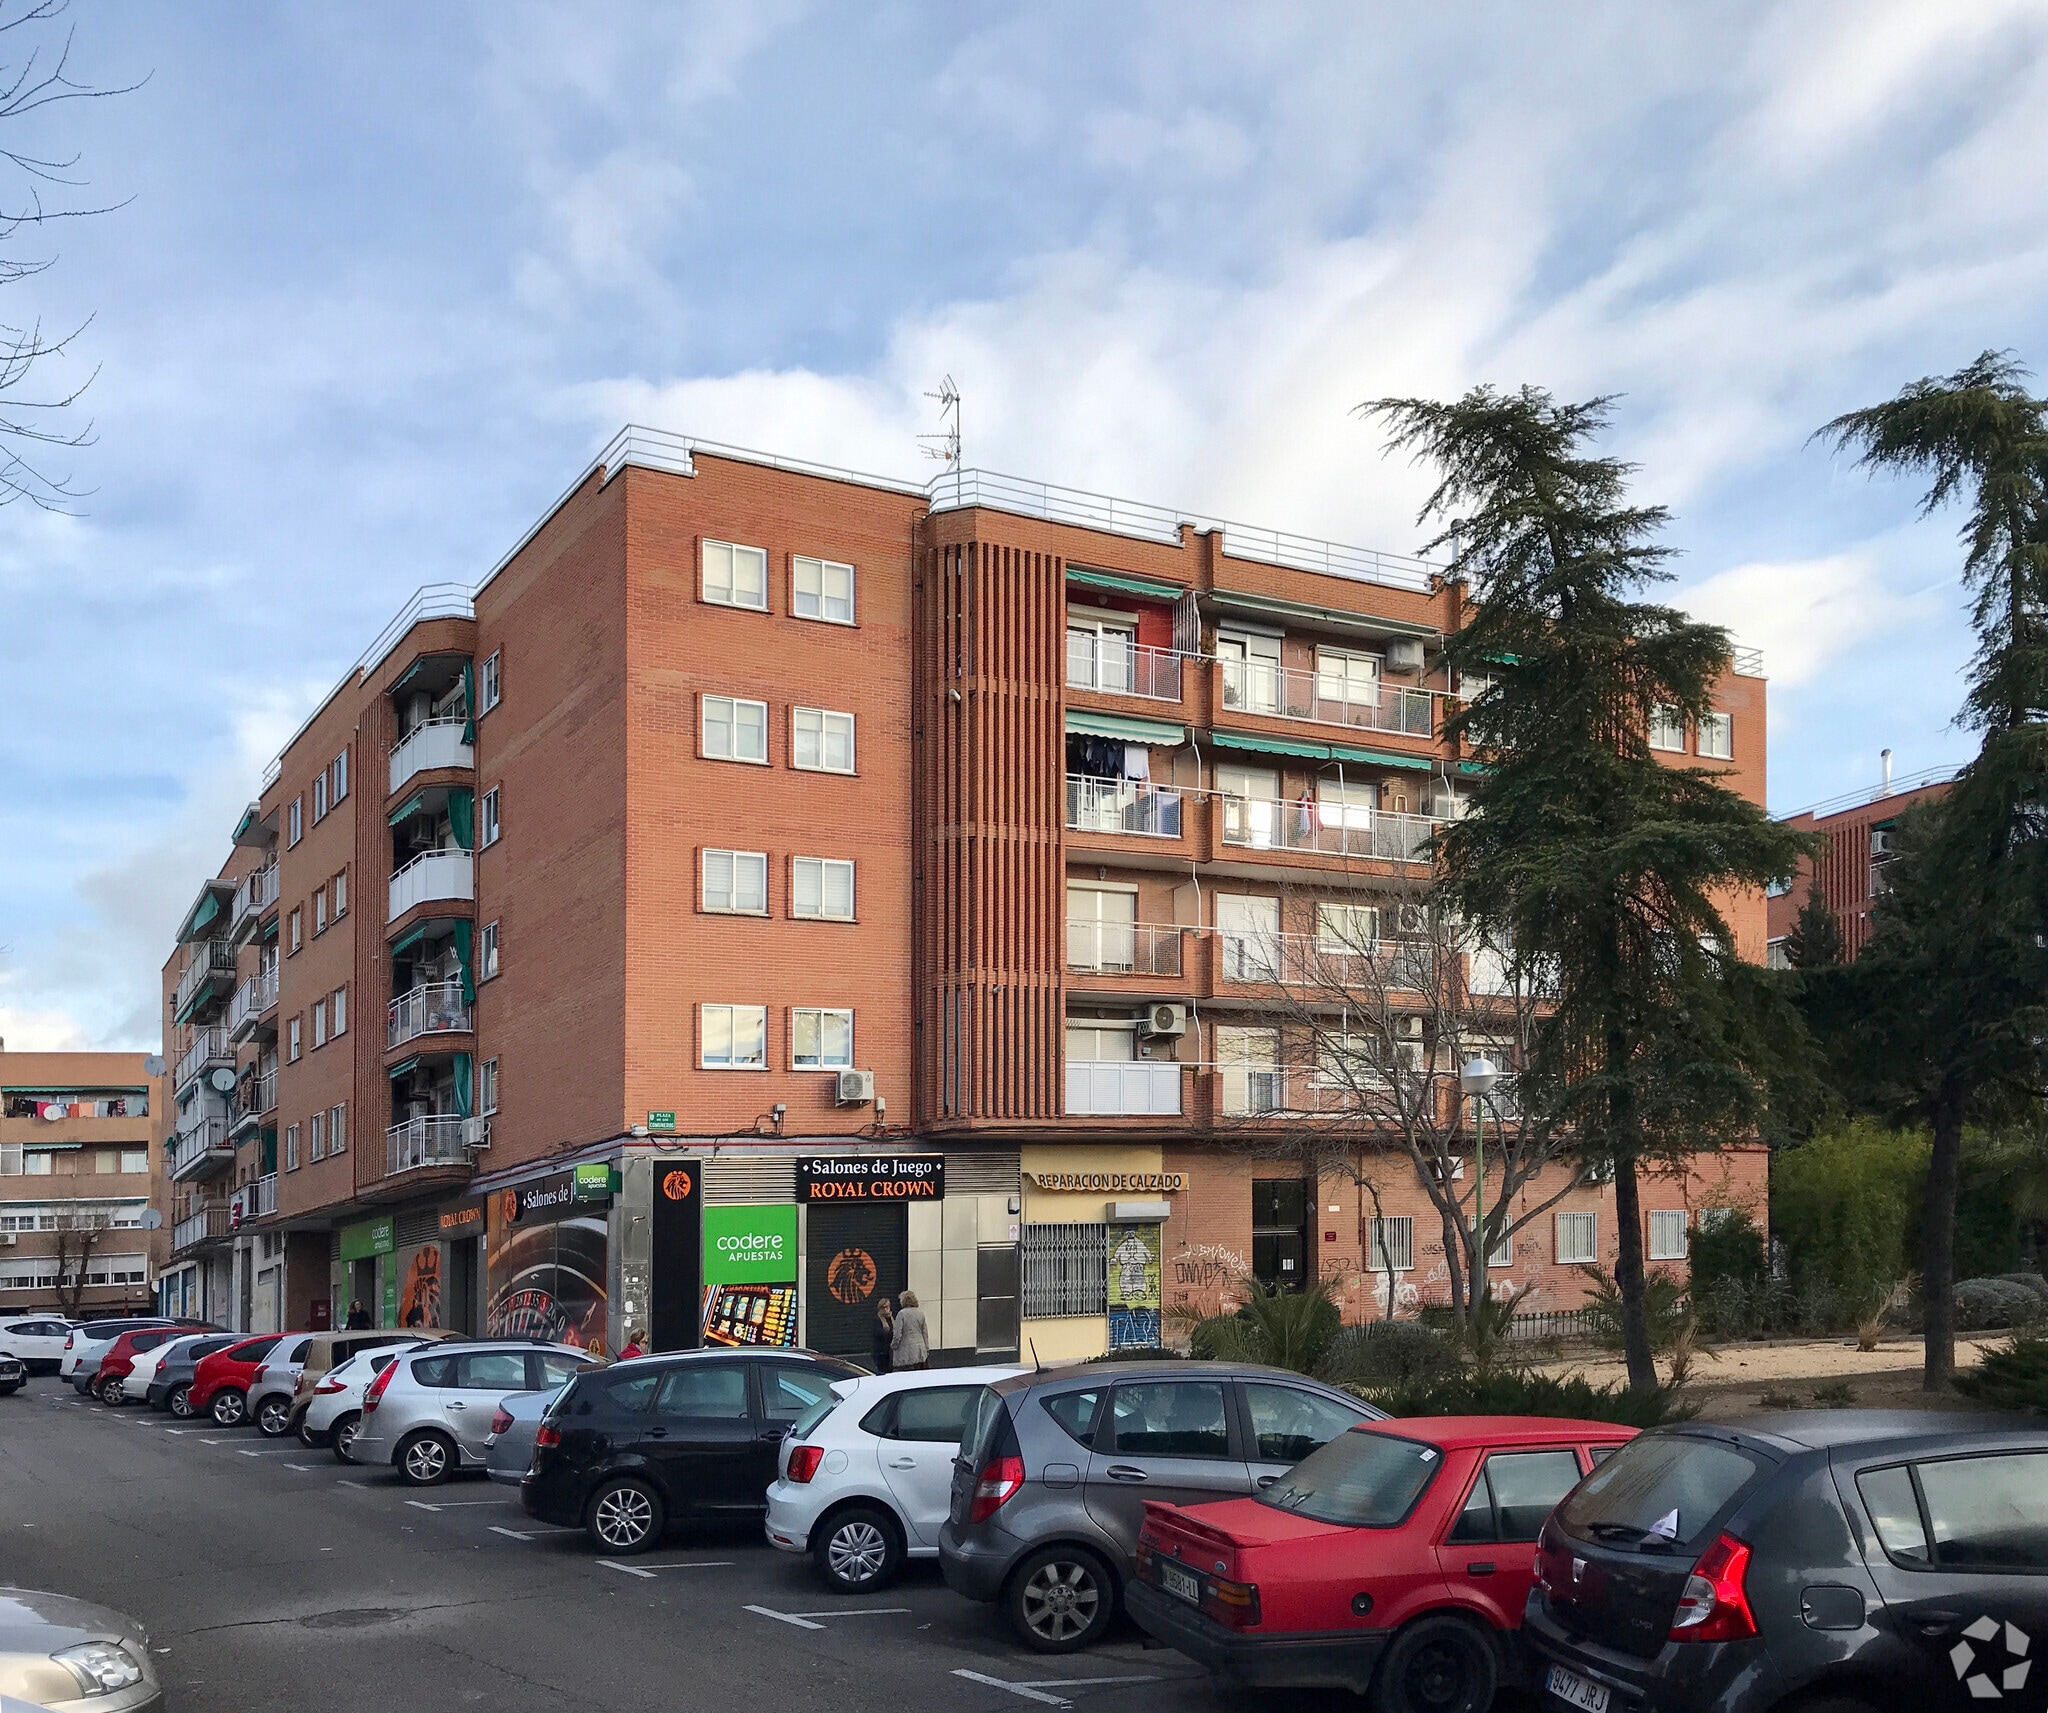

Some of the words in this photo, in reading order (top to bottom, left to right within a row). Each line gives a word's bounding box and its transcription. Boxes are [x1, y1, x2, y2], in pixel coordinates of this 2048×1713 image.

[812, 1159, 867, 1175] Salones
[872, 1159, 888, 1174] de
[892, 1159, 932, 1177] Juego
[578, 1175, 606, 1184] codere
[1038, 1174, 1110, 1188] REPARACION
[1112, 1174, 1126, 1188] DE
[1129, 1174, 1182, 1188] CALZADO
[527, 1189, 557, 1209] Salones
[558, 1184, 568, 1202] de
[809, 1182, 867, 1198] ROYAL
[870, 1181, 935, 1197] CROWN
[371, 1225, 390, 1240] codere
[716, 1232, 783, 1251] codere
[728, 1251, 783, 1262] APUESTAS
[540, 1297, 547, 1311] 3
[1553, 1670, 1580, 1699] 9477
[1580, 1684, 1606, 1711] JRJ
